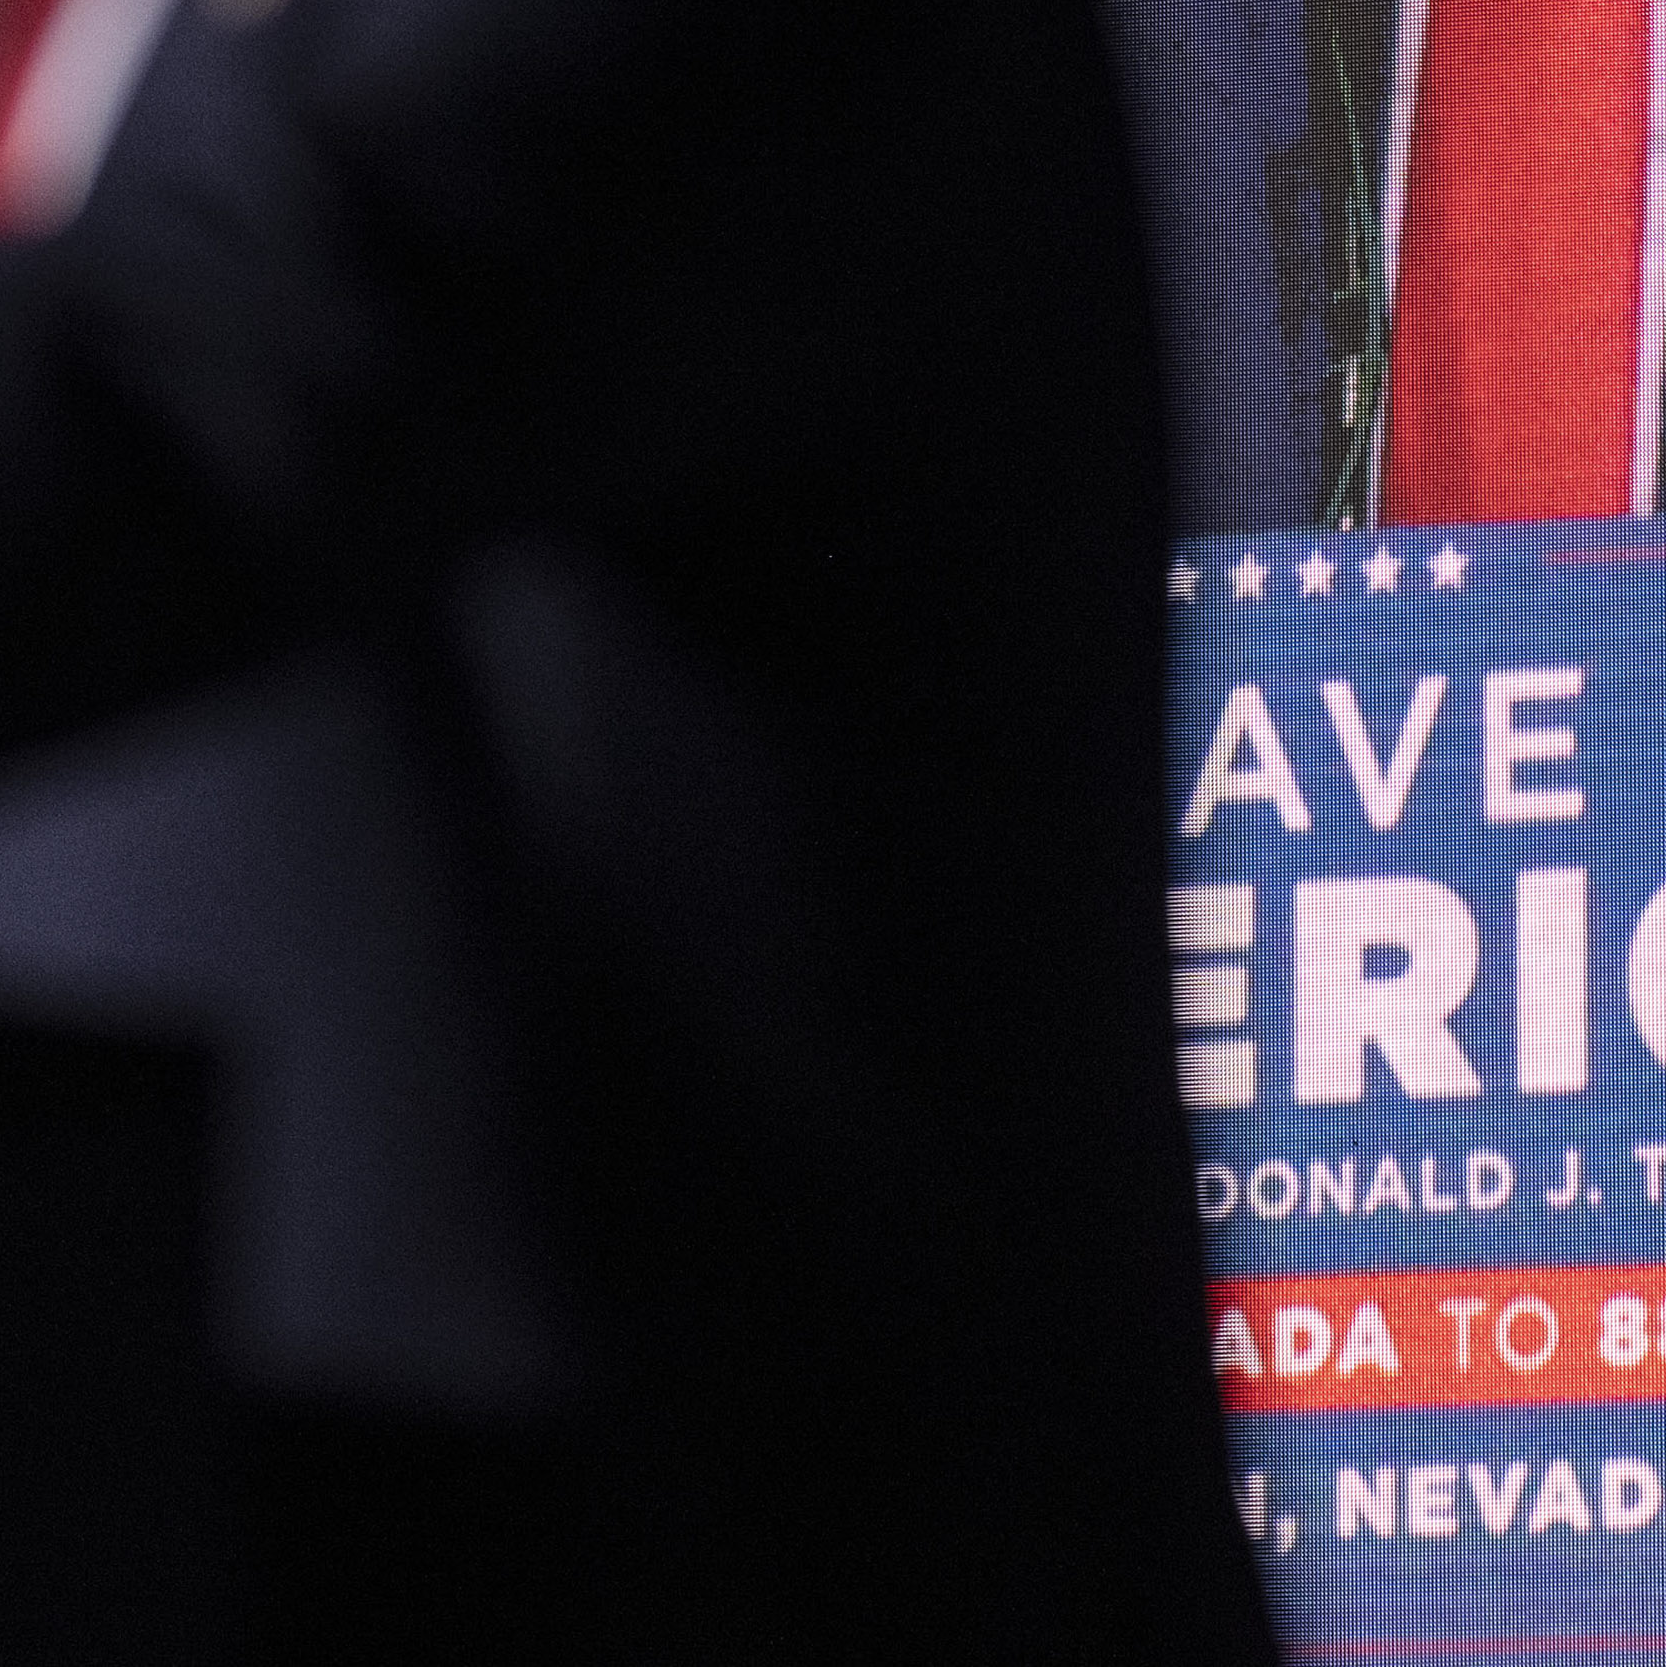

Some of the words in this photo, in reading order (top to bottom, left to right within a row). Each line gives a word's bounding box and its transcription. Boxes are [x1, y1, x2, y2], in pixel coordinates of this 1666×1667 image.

[1197, 1149, 1517, 1224] DONALD
[1545, 1147, 1604, 1210] J.
[1437, 1294, 1561, 1374] TO
